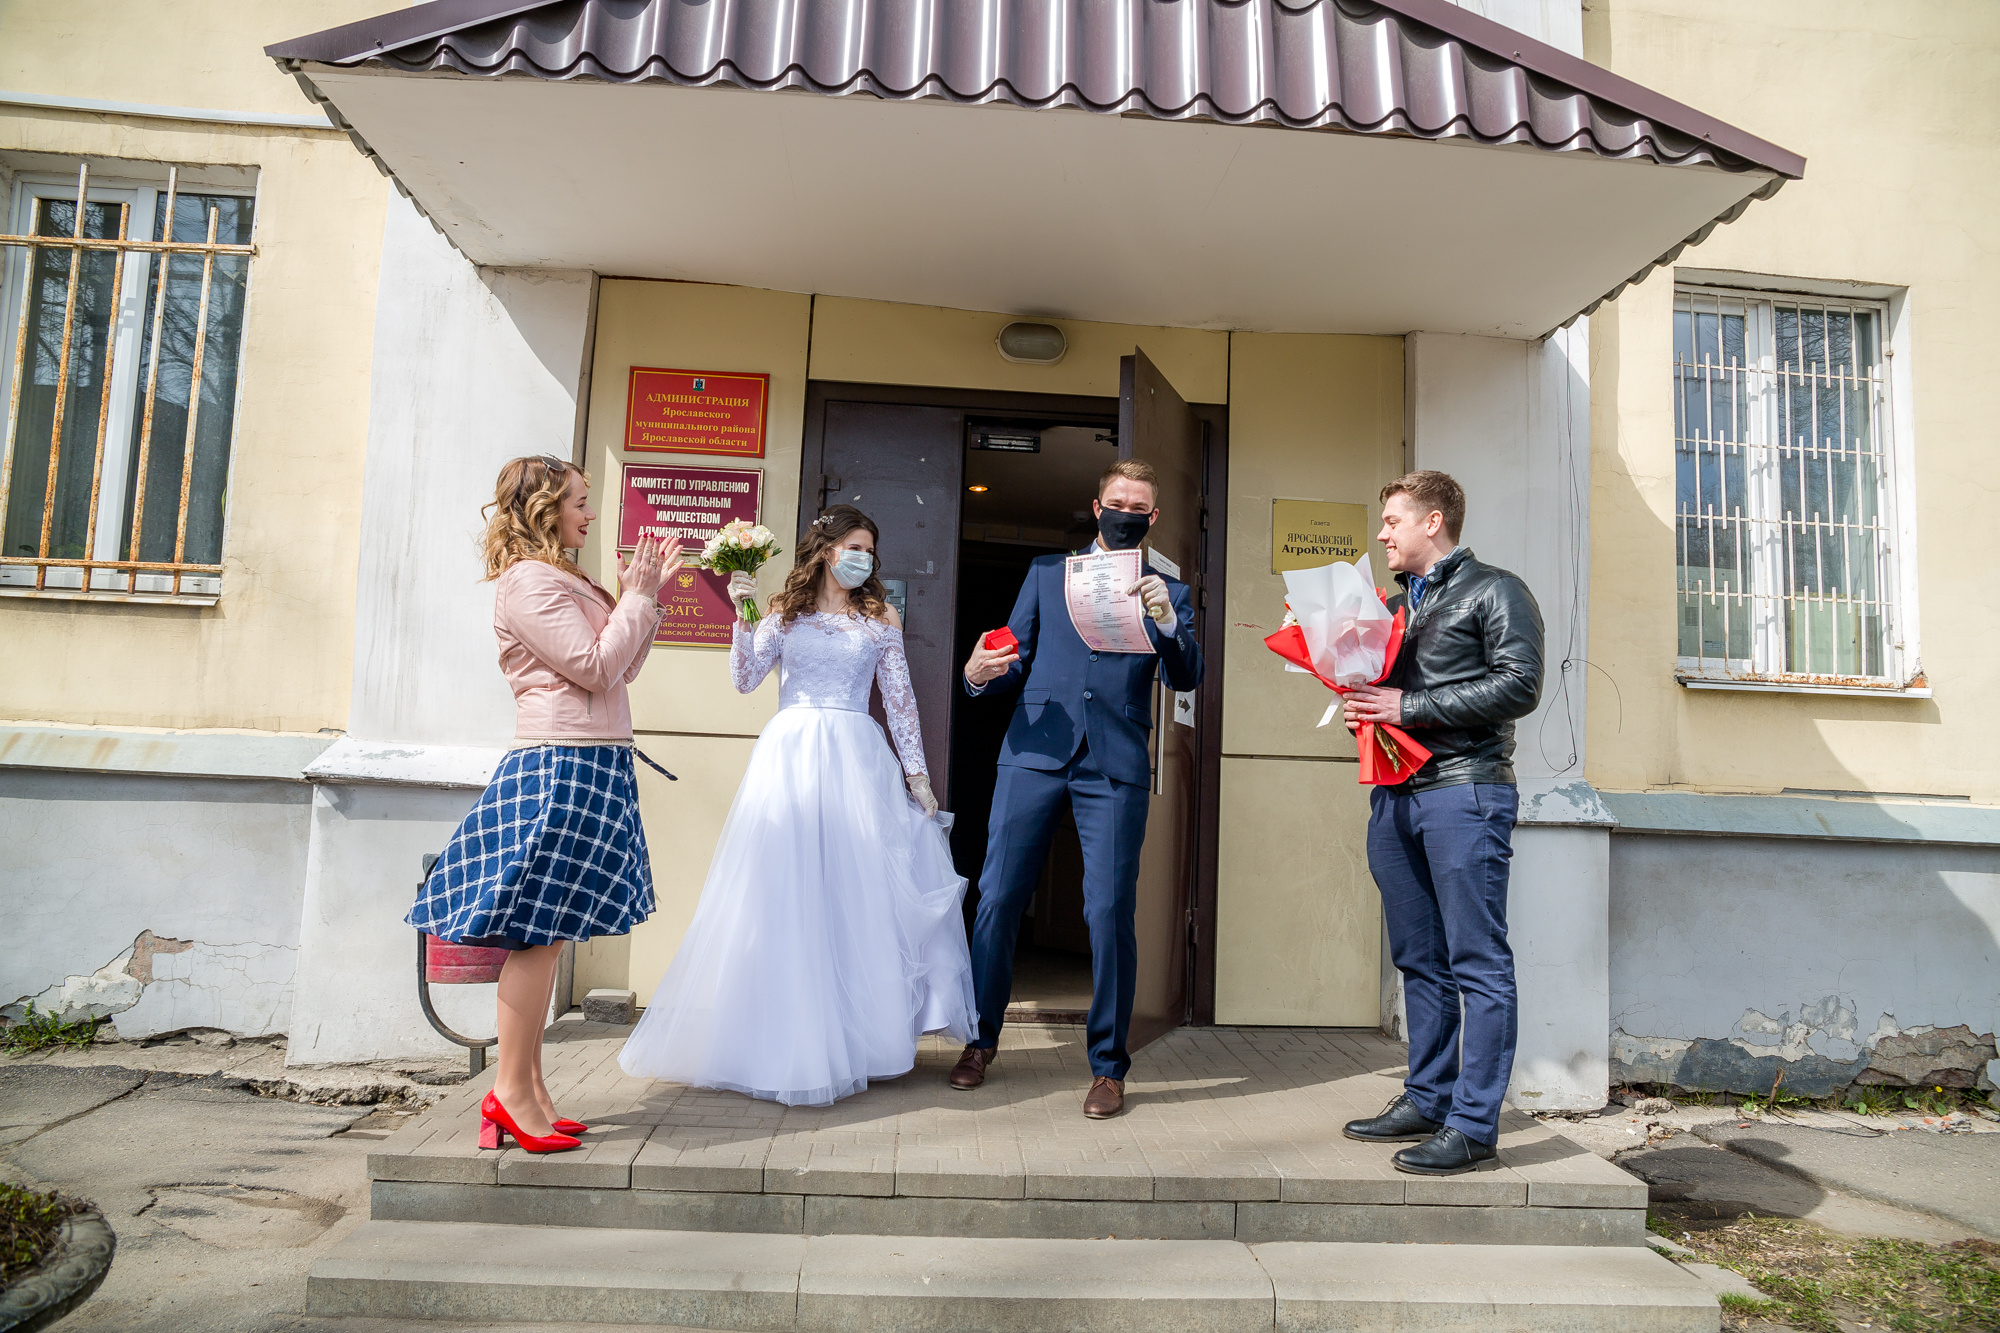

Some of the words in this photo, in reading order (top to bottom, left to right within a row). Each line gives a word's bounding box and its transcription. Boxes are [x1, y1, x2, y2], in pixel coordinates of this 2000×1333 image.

[646, 393, 749, 407] АДМИНИСТРАЦИЯ
[662, 407, 731, 419] Ярославского
[635, 420, 719, 432] муниципального
[721, 423, 756, 434] района
[641, 432, 706, 444] Ярославской
[708, 436, 748, 447] области
[631, 476, 673, 489] КОМИТЕТ
[674, 478, 687, 490] ПО
[688, 479, 750, 493] УПРАВЛЕНИЮ
[647, 493, 732, 509] МУНИЦИПАЛЬНЫМ
[656, 510, 721, 525] ИМУЩЕСТВОМ
[1310, 519, 1331, 527] Газета
[1287, 533, 1353, 545] ЯРОСЛАВСКИЙ
[1281, 544, 1358, 557] АгроКУРЬЕР
[672, 595, 698, 603] Отдел
[665, 604, 704, 617] ЗАГС
[699, 622, 731, 630] района
[694, 630, 730, 638] области
